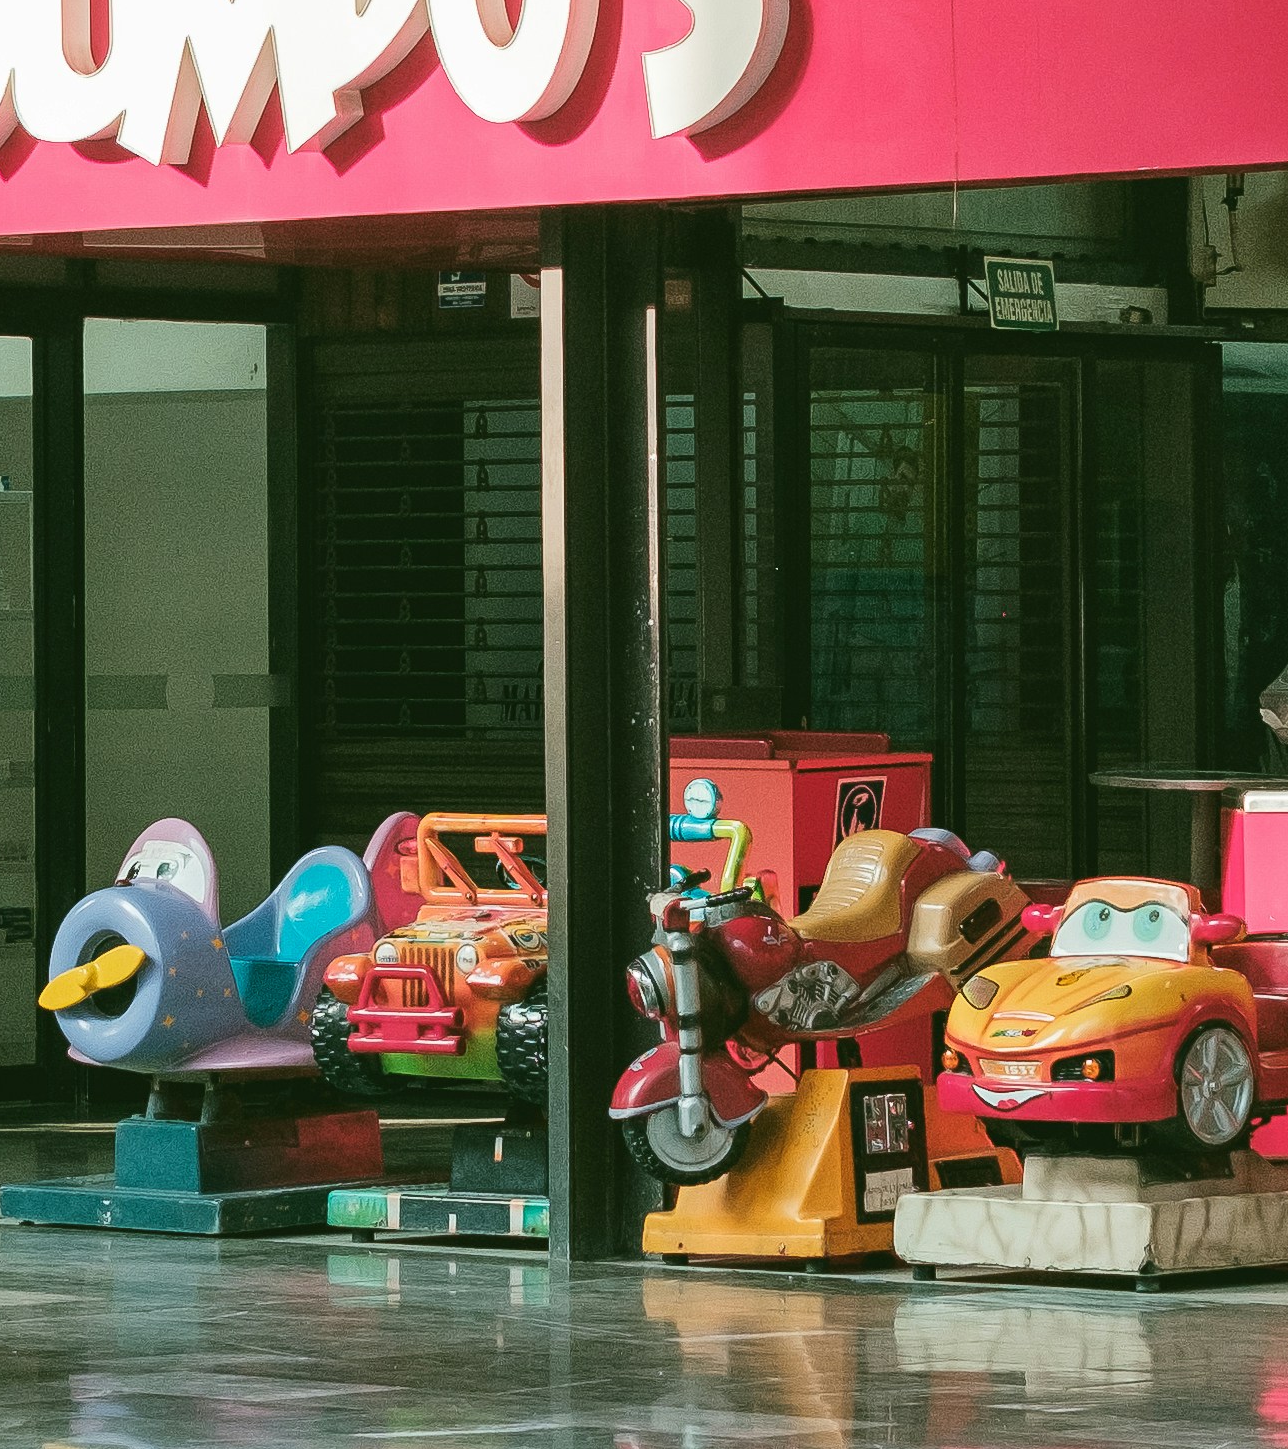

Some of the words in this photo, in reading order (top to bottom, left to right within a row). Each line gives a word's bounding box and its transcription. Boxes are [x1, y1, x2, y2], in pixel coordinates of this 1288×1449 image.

[997, 269, 1030, 293] SALIDA
[1031, 272, 1044, 295] DE
[995, 297, 1053, 323] EMERGENCIA
